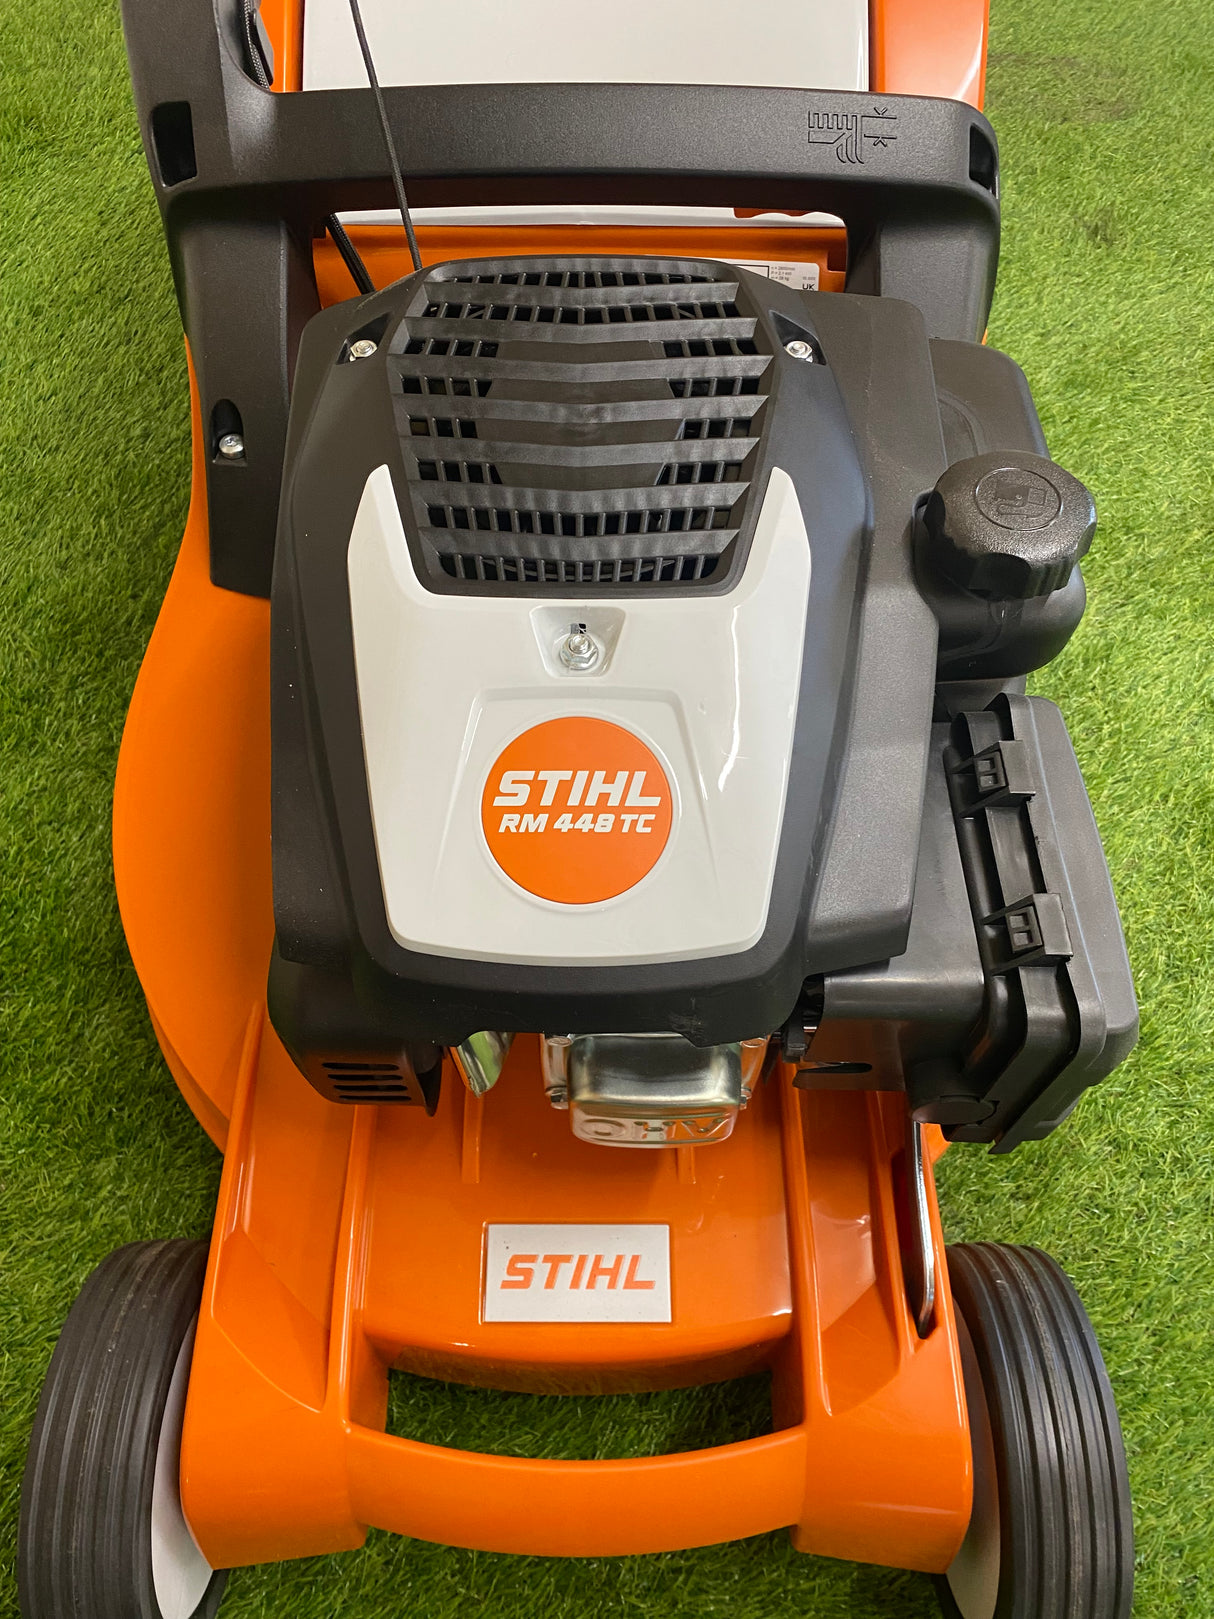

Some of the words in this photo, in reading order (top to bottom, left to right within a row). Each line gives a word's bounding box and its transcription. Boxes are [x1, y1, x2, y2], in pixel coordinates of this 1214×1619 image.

[802, 283, 815, 291] UK
[492, 770, 662, 807] STIHL
[498, 813, 549, 833] RM
[553, 813, 616, 833] 448
[619, 813, 656, 833] TC
[499, 1254, 656, 1290] STIHL
